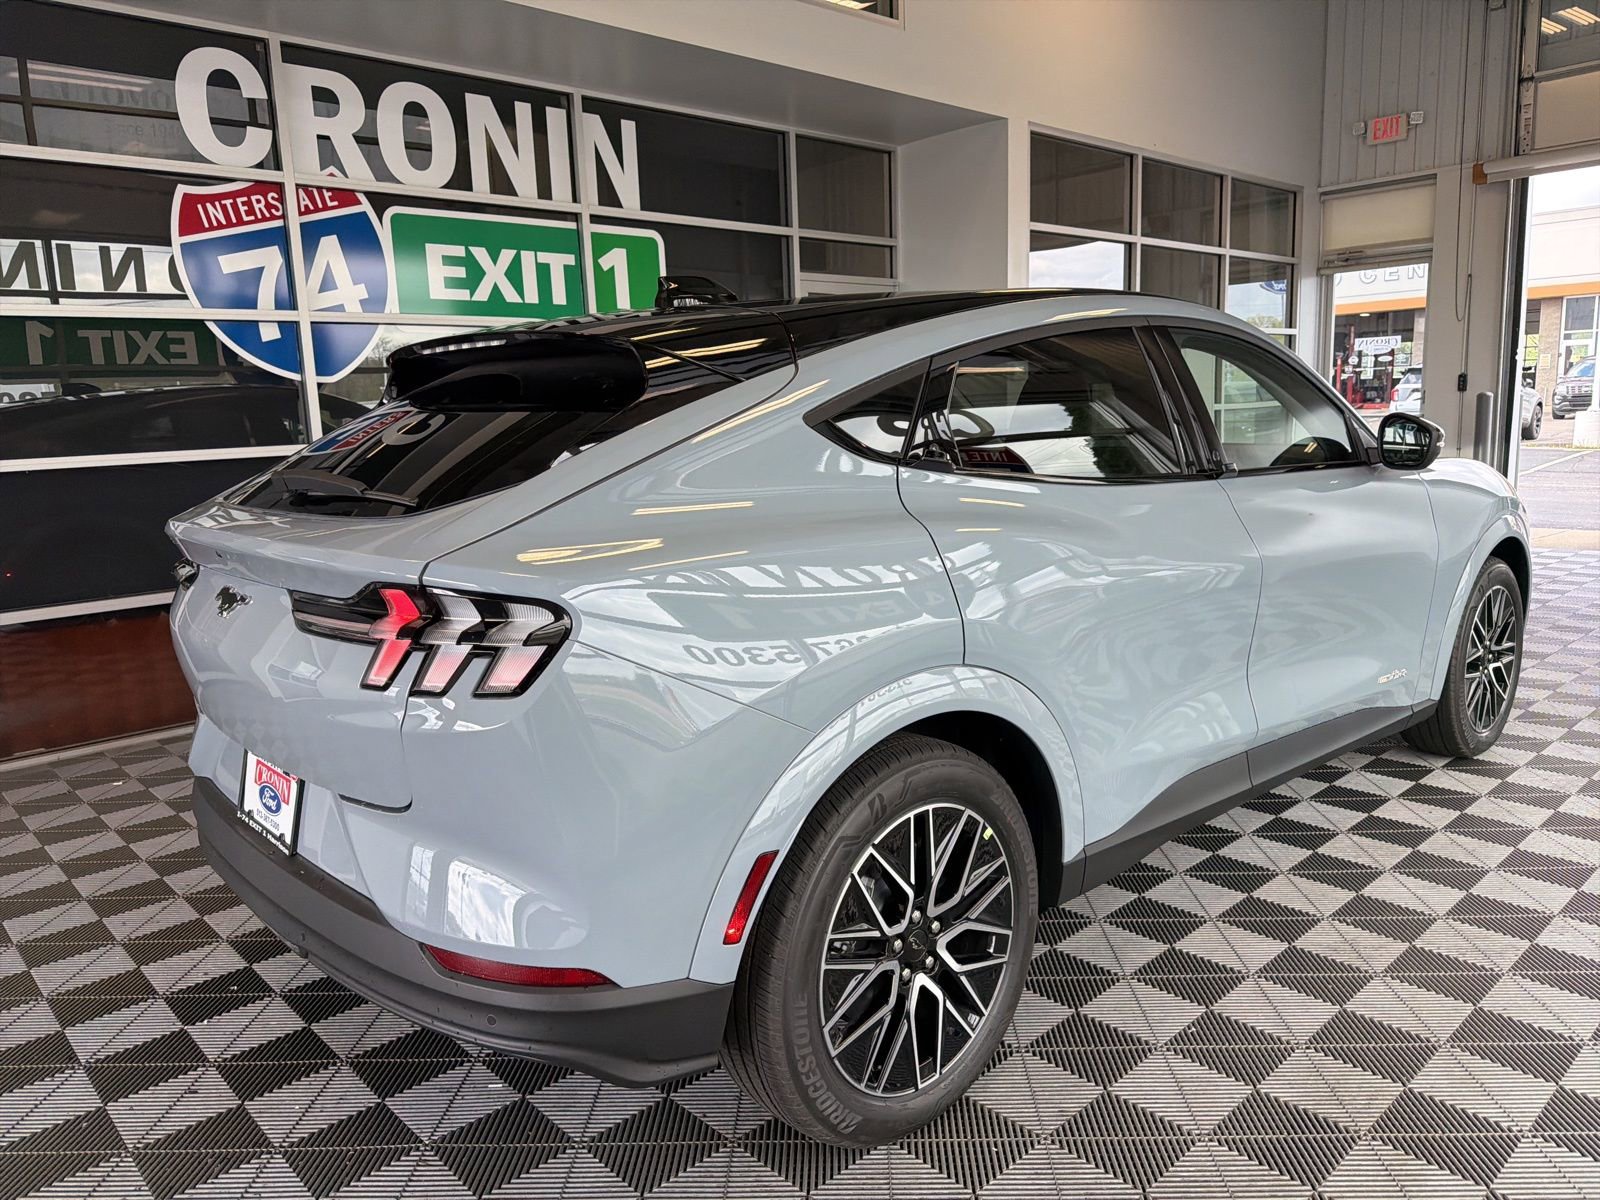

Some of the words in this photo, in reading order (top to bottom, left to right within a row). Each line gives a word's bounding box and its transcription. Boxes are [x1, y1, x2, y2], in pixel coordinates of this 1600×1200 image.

[174, 46, 641, 210] CRONIN
[1373, 116, 1400, 141] EXIT
[197, 188, 339, 229] INTERSATE
[217, 234, 369, 343] 74
[425, 243, 576, 305] EXIT
[597, 247, 632, 311] 1
[256, 764, 291, 804] CRONIN
[262, 788, 278, 811] Ford
[248, 820, 262, 834] EXIT
